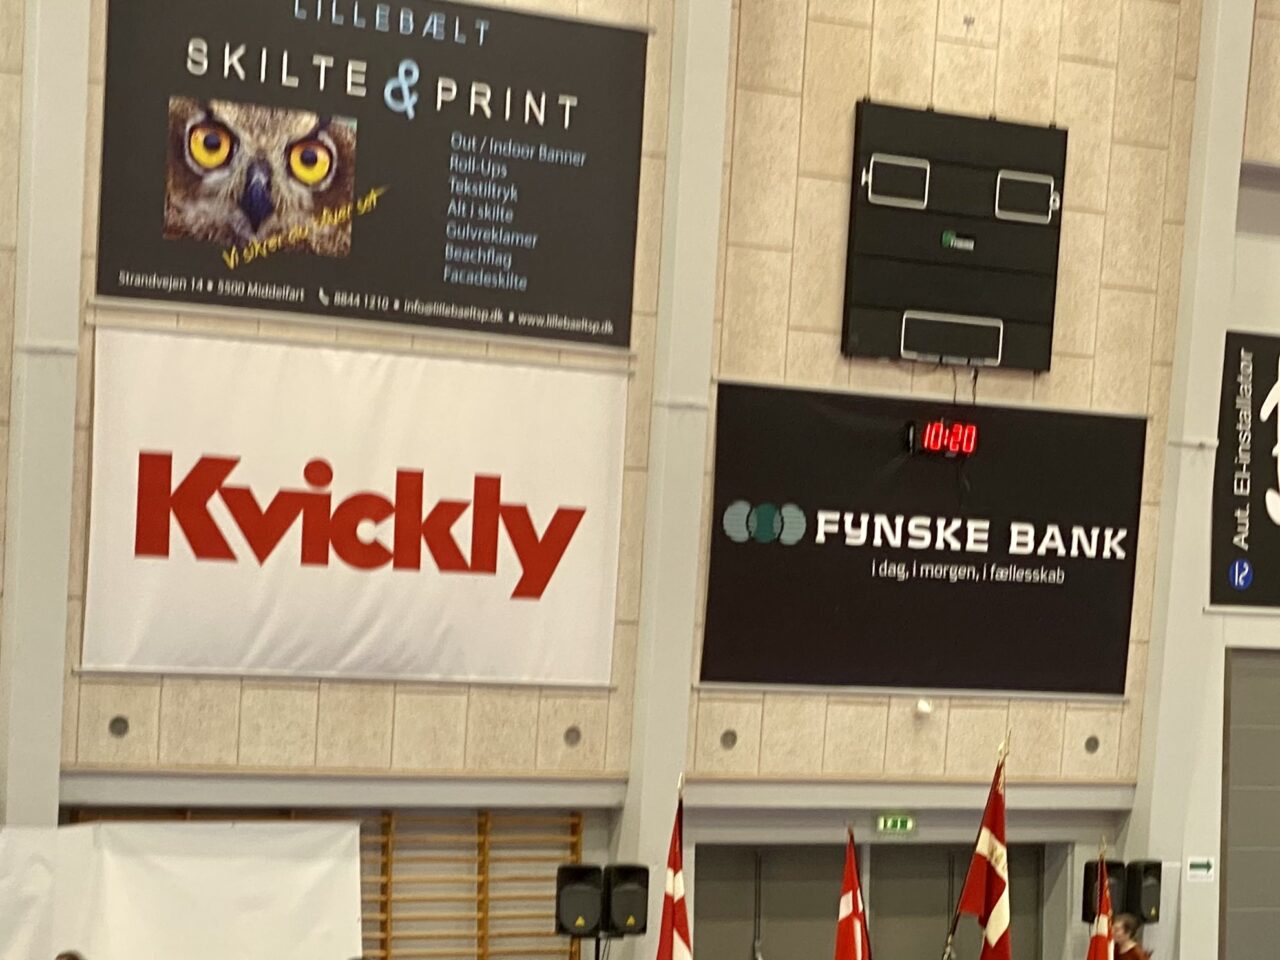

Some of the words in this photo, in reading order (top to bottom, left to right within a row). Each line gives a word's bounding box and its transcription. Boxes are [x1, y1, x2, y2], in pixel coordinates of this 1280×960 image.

[294, 0, 490, 46] LILLEBÆLT
[186, 37, 368, 98] SKILTE
[383, 58, 420, 120] &
[436, 76, 578, 130] PRINT
[450, 131, 477, 153] Out
[489, 136, 536, 160] Indoor
[538, 143, 587, 167] Banner
[449, 153, 508, 179] Roll-Ups
[449, 176, 519, 203] Tekstiltryk
[447, 198, 467, 218] Alt
[477, 201, 515, 224] skilte
[446, 219, 539, 249] Gulvreklamer
[444, 242, 513, 272] Beachflag
[118, 270, 187, 293] Strandvejen
[190, 276, 204, 293] 14
[247, 280, 305, 303] Middelfart
[443, 264, 528, 292] Facadeskilte
[923, 422, 976, 453] 10:20
[133, 449, 587, 601] Kvickly
[815, 509, 990, 553] FYNSKE
[1008, 521, 1128, 560] BANK
[1232, 503, 1250, 551] Aut.
[878, 559, 909, 581] dag,
[919, 562, 980, 584] morgen,
[989, 562, 1065, 585] fællesskab
